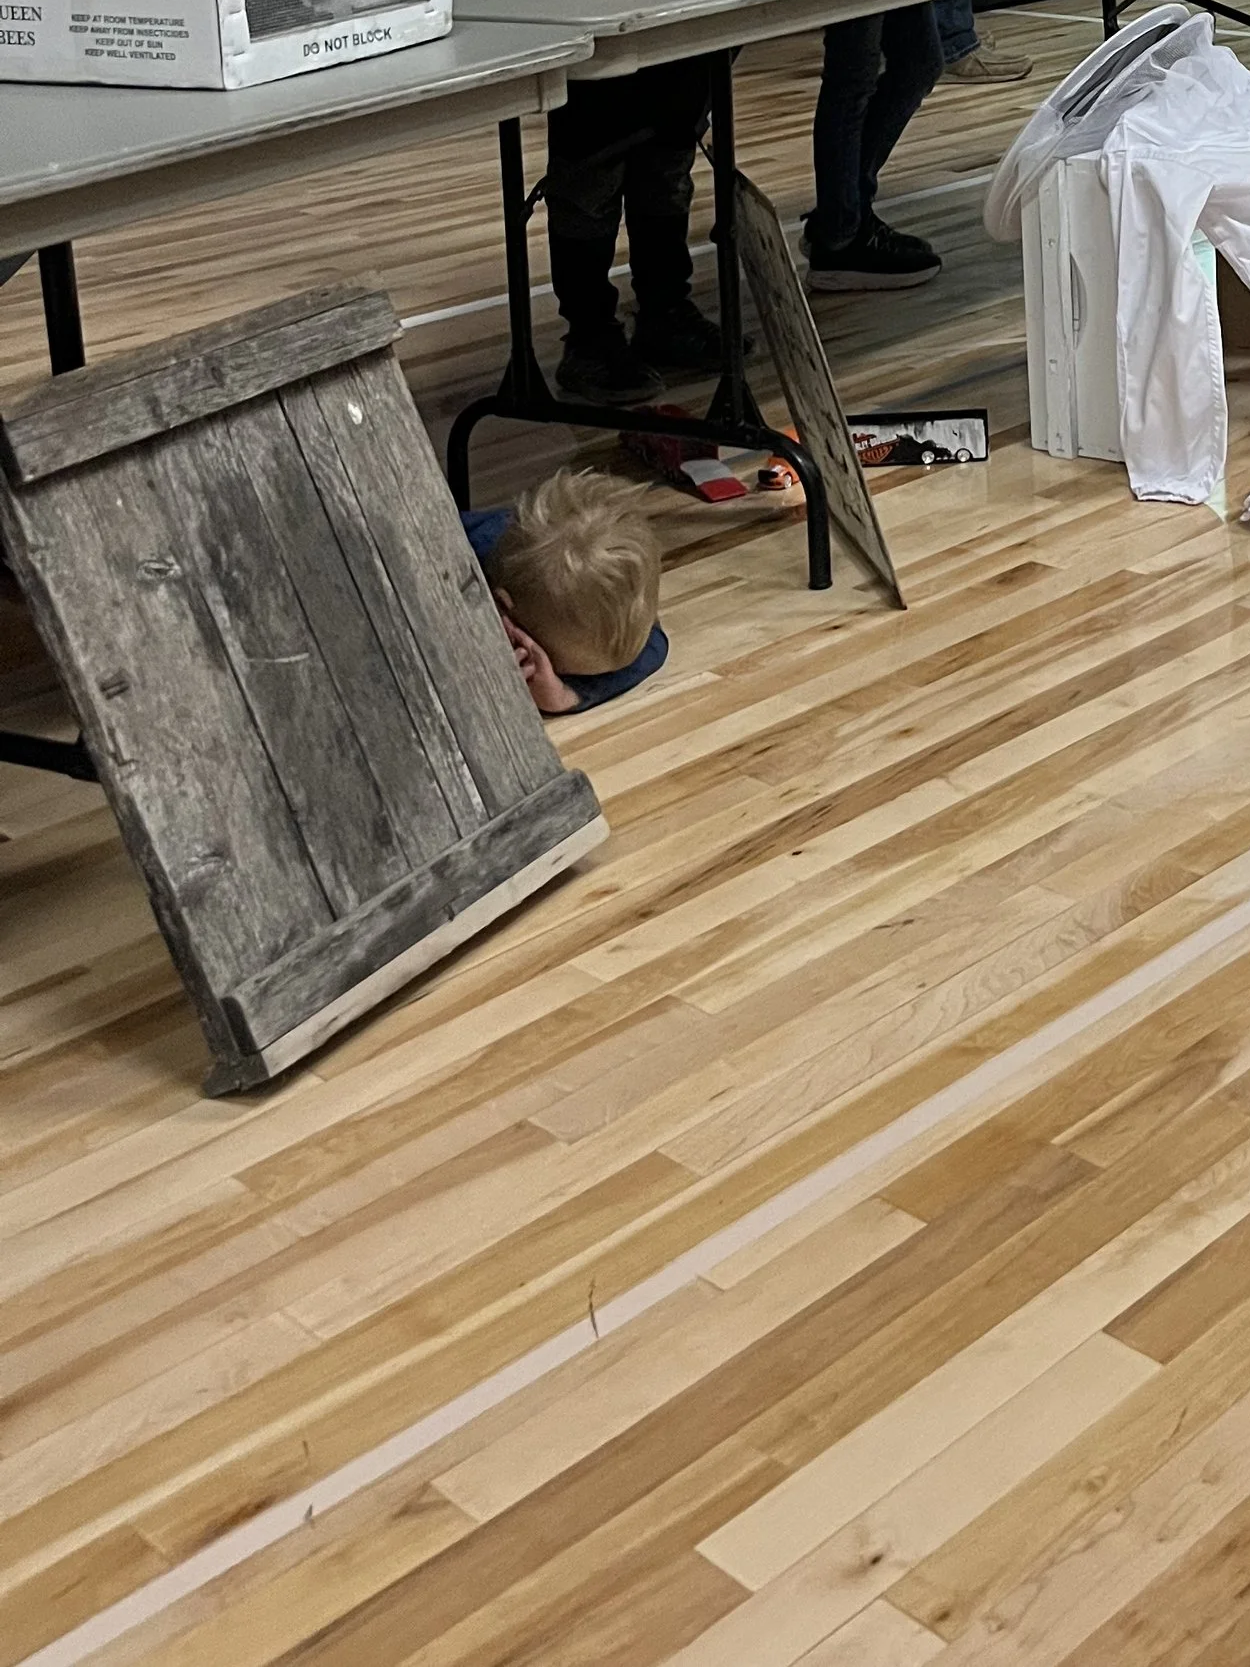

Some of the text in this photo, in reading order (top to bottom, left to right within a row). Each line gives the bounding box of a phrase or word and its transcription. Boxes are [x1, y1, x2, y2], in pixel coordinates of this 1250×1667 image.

[0, 4, 42, 22] UEEN
[71, 13, 185, 27] KEEP AT ROOM TEMPERATURE
[0, 29, 36, 47] BEES
[69, 25, 89, 33] KEEP
[112, 27, 135, 36] FROM
[136, 28, 190, 39] INSECTICIDES
[95, 37, 163, 49] KEEP OUT OF SUN
[303, 27, 393, 58] DO NOT BLOCK
[85, 48, 176, 61] KEEP WELL VENTILATED
